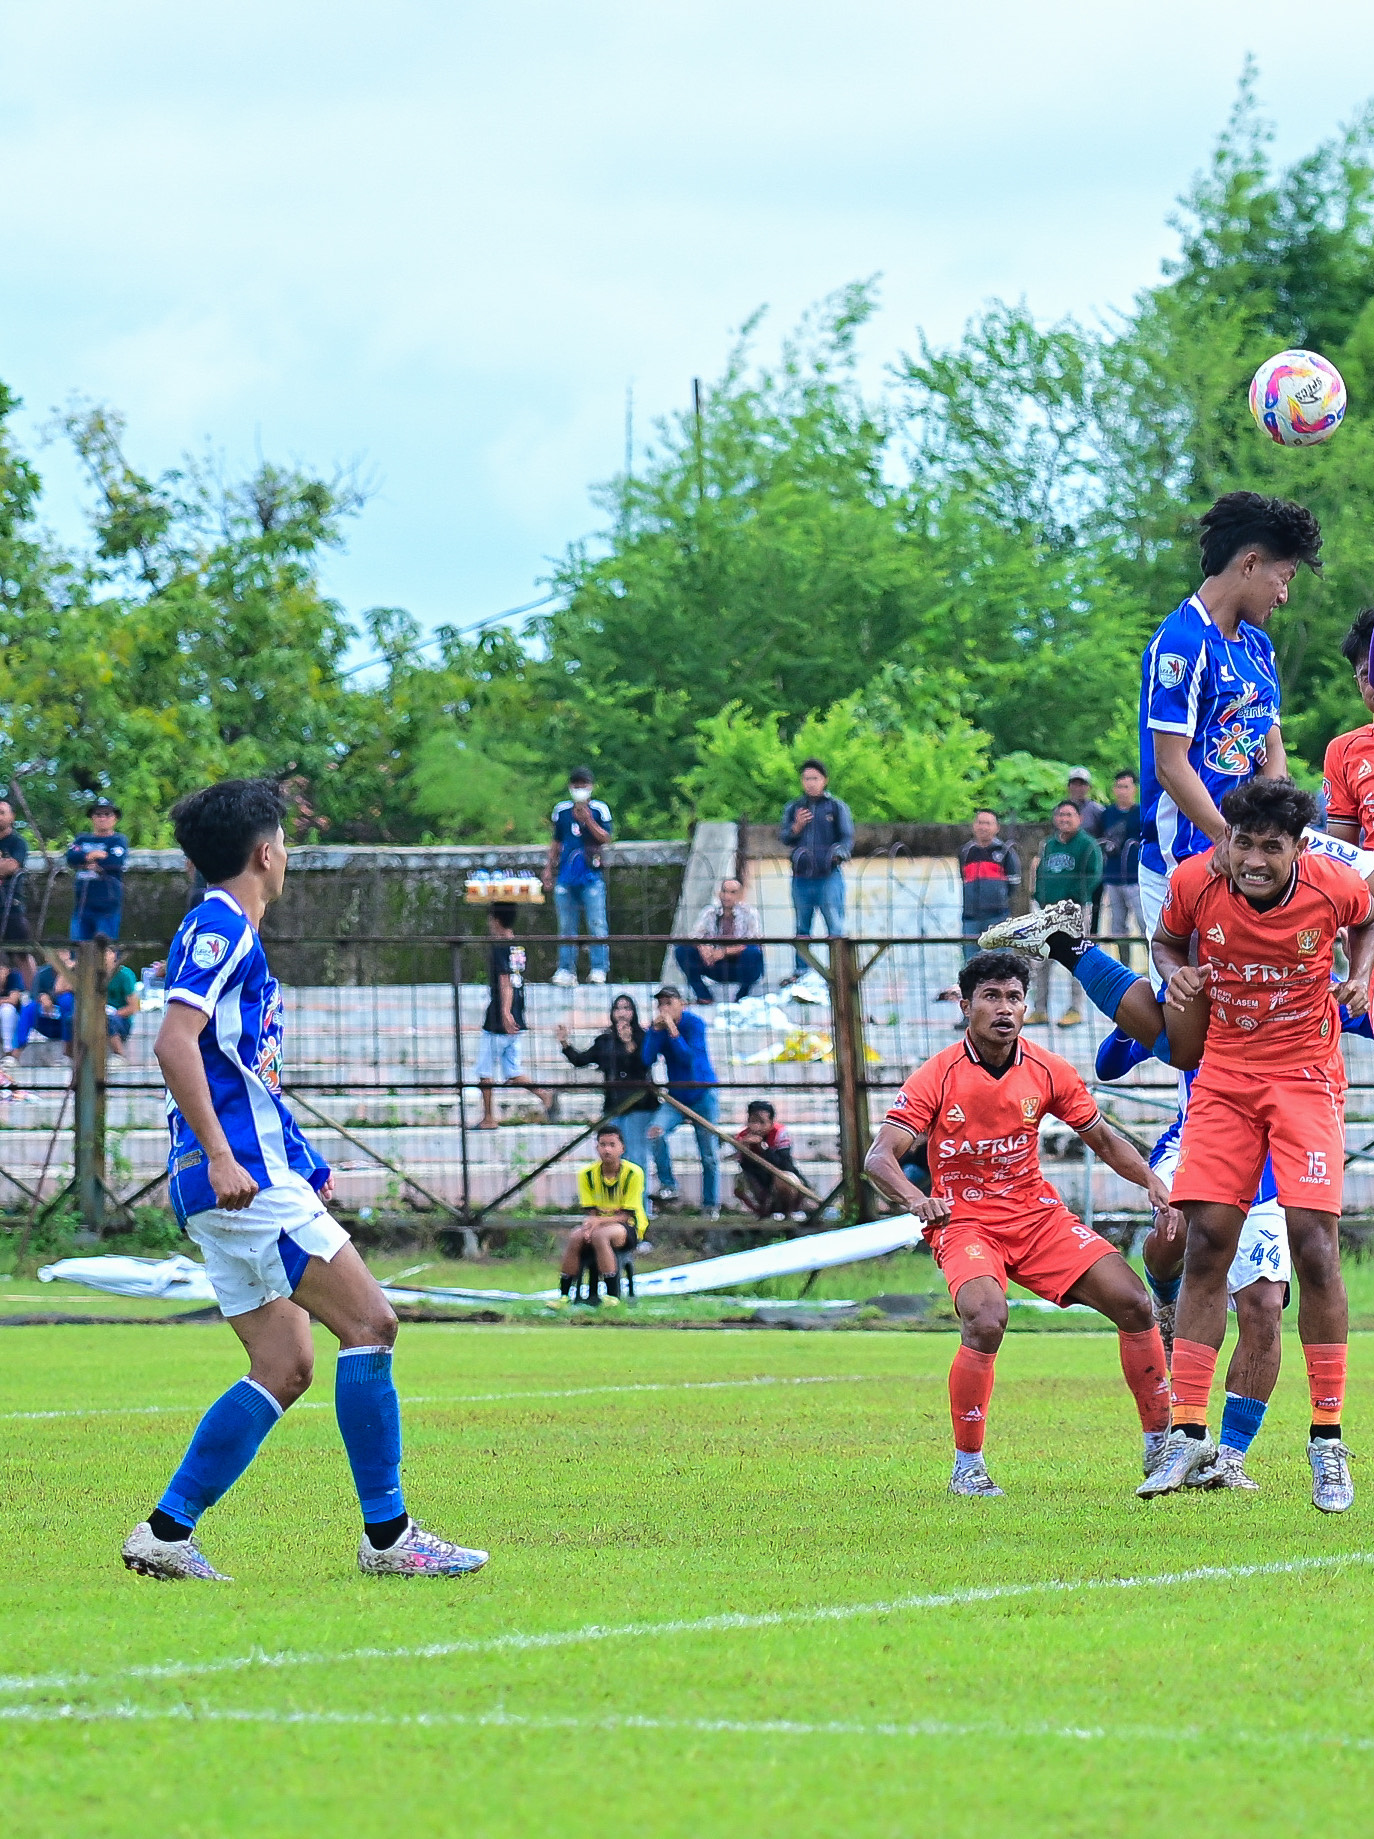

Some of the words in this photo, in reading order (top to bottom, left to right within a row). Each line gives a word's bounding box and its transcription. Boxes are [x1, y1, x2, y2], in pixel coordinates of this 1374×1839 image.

[1231, 999, 1258, 1009] LASEM
[939, 1134, 1028, 1158] SAFRIA
[1306, 1151, 1327, 1177] 15
[1071, 1225, 1092, 1240] 9
[1250, 1242, 1281, 1270] 44
